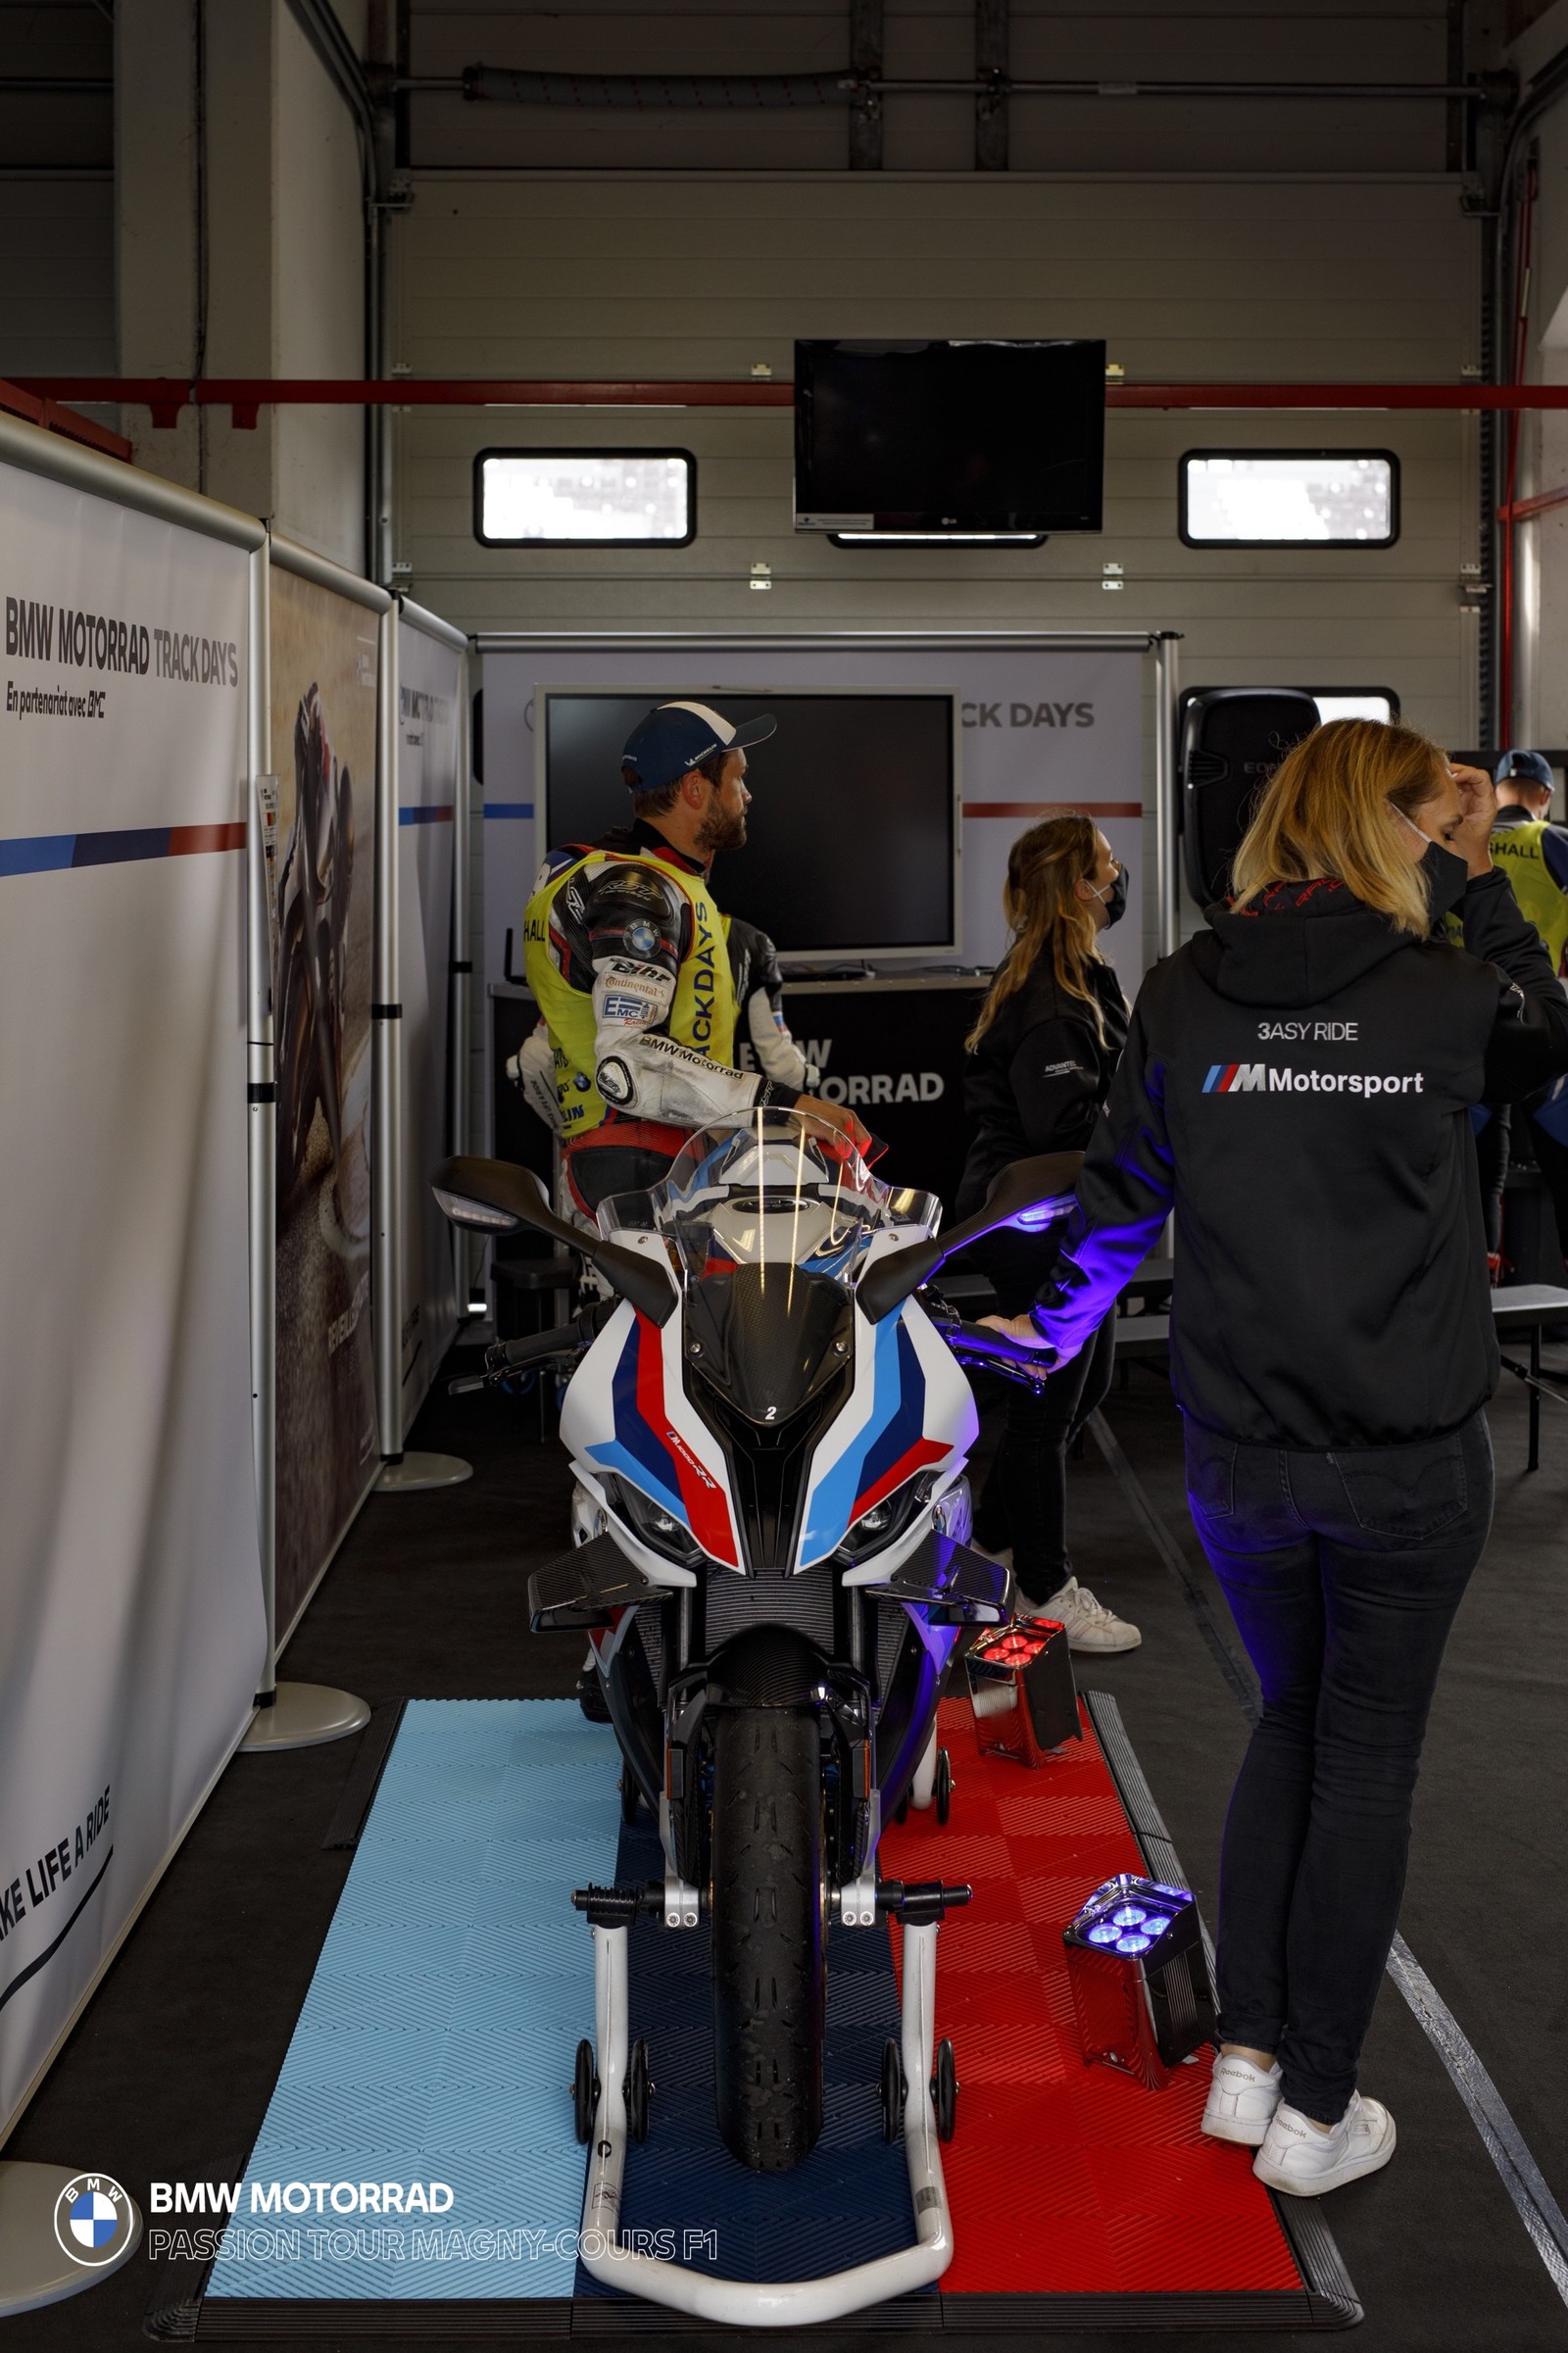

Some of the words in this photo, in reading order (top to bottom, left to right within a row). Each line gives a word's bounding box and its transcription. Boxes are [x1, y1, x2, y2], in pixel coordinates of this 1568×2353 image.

[6, 596, 54, 662] BMW
[58, 608, 150, 675] MOTORRAD
[154, 628, 199, 683] TRACK
[202, 638, 238, 688] DAYS
[7, 681, 18, 711] En
[20, 685, 67, 720] partenariat
[69, 695, 86, 717] avec
[961, 703, 1003, 727] CK
[1009, 703, 1095, 727] DAYS
[605, 976, 659, 996] Continental
[1257, 1022, 1311, 1041] 3ASY
[1313, 1022, 1358, 1041] RIDE
[638, 1035, 679, 1056] BMW
[678, 1049, 745, 1080] Motorrad
[1268, 1067, 1425, 1099] Motorsport
[764, 1405, 777, 1420] 2
[25, 1838, 72, 1908] LIFE
[74, 1825, 84, 1869] A
[85, 1784, 111, 1852] RIDE
[1220, 2067, 1256, 2083] Reebok
[1275, 2115, 1307, 2139] Reebok
